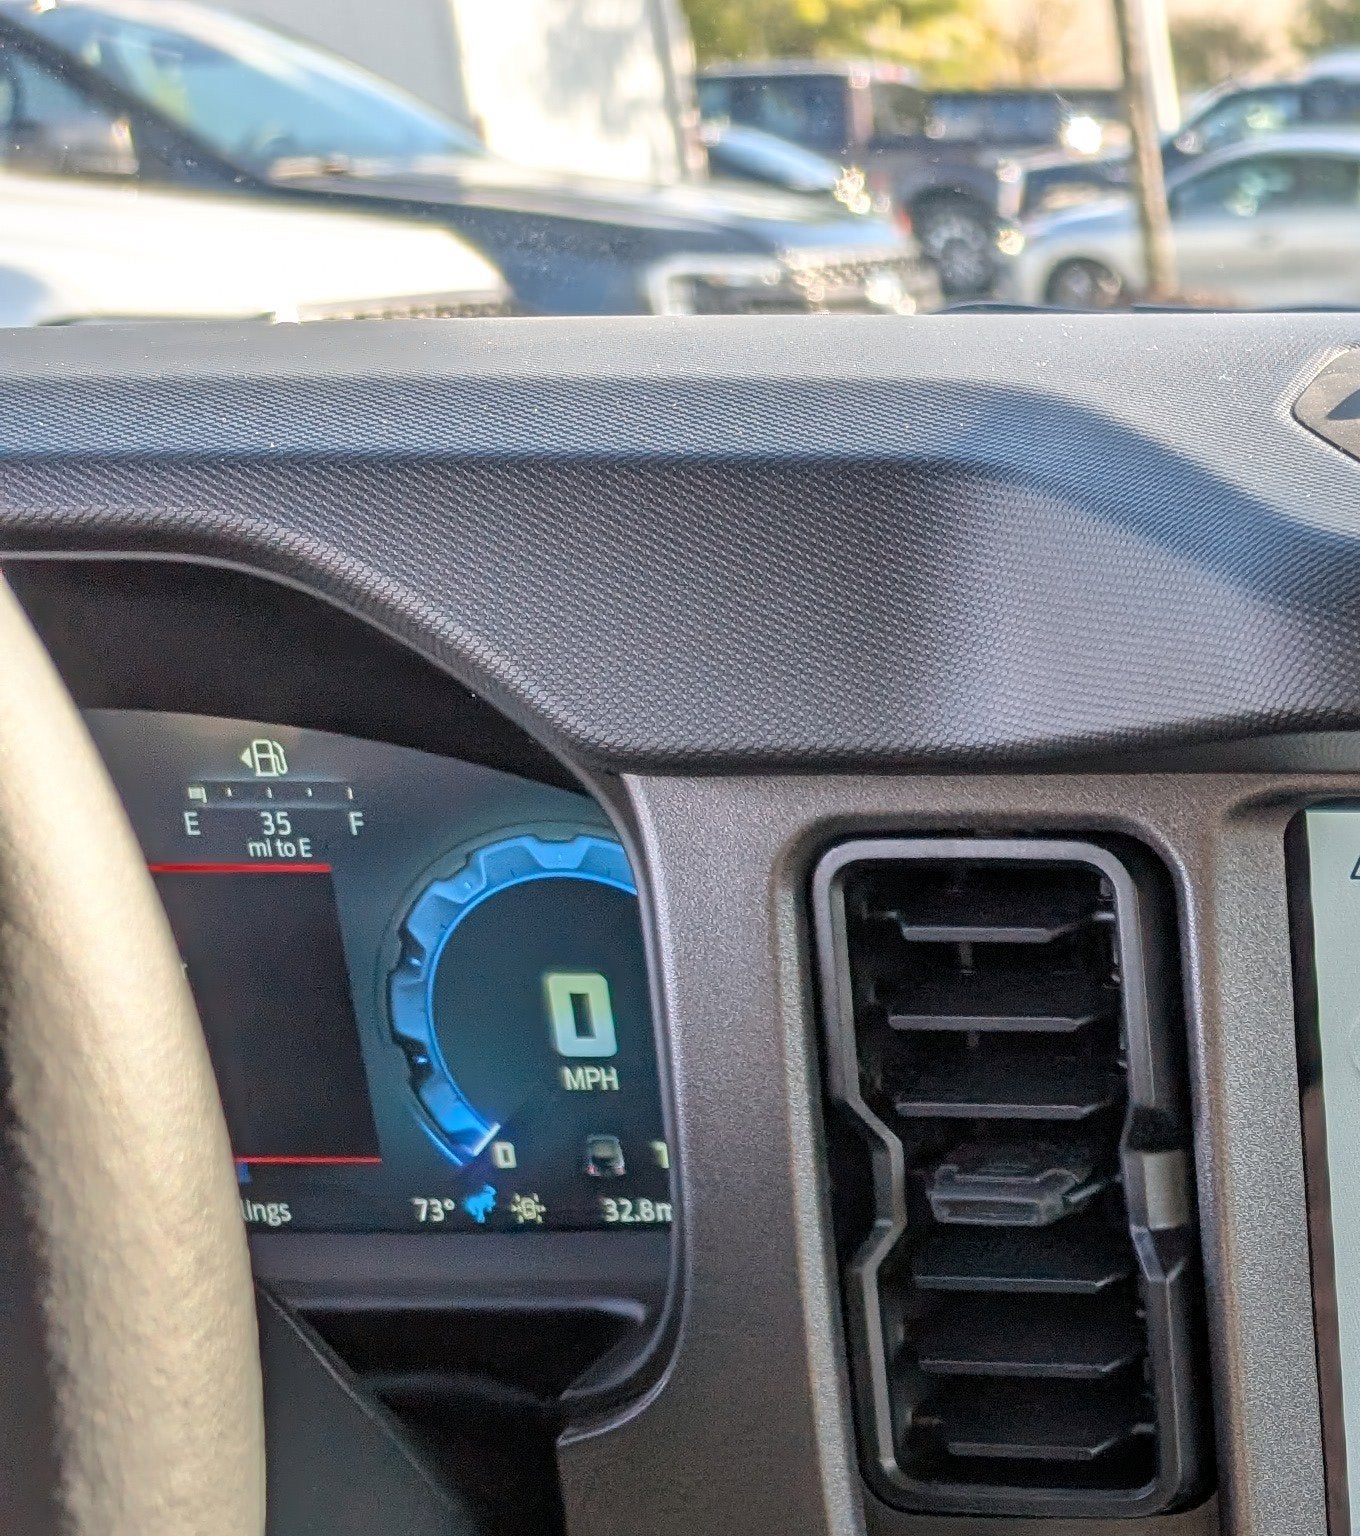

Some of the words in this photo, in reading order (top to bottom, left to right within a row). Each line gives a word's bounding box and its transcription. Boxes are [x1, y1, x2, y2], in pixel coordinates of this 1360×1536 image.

[184, 812, 201, 835] E
[261, 812, 291, 835] 35
[348, 812, 364, 835] F
[276, 839, 295, 857] to
[299, 838, 312, 858] E
[547, 973, 617, 1057] 0
[564, 1067, 620, 1091] MPH
[492, 1141, 517, 1169] 0
[412, 1198, 455, 1222] 73°
